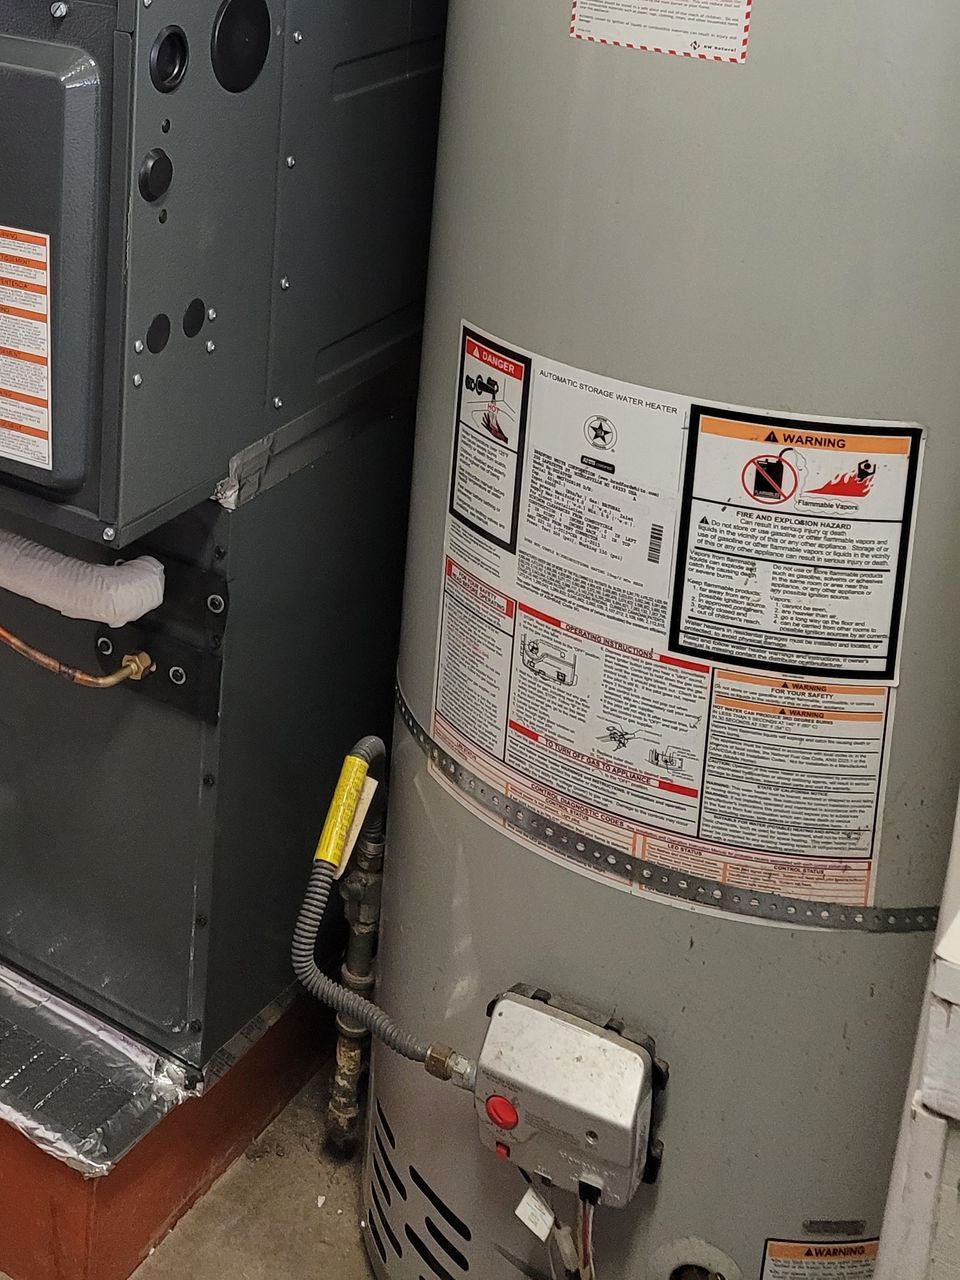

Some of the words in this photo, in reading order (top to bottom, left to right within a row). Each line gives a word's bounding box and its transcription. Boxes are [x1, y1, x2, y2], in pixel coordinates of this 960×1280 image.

[482, 350, 515, 374] DANGER
[539, 370, 578, 388] AUTOMATIC
[579, 382, 614, 399] STORAGE
[616, 393, 644, 407] WATER
[645, 401, 679, 415] HEATER
[783, 433, 846, 449] WARNING
[797, 499, 834, 509] Flammable
[736, 510, 753, 518] FIRE
[774, 517, 818, 527] EXPLOSION
[733, 524, 748, 532] store
[770, 530, 796, 539] gasoline
[806, 533, 821, 541] other
[804, 527, 820, 535] injury
[565, 624, 602, 644] OPERATING
[603, 638, 653, 659] INSTRUCTIONS
[792, 683, 827, 692] WARNING
[790, 710, 824, 718] WARNING
[544, 739, 553, 748] TO
[554, 742, 571, 756] TURN
[572, 750, 585, 762] OFF
[589, 757, 601, 769] GAS
[601, 763, 611, 771] TO
[610, 765, 651, 785] APPLIANCE
[531, 783, 559, 801] CONTROL
[561, 797, 600, 818] DIAGNOSTIC
[601, 814, 624, 827] CODES
[545, 798, 569, 812] CONTROL
[570, 808, 589, 821] STATUS
[667, 843, 679, 851] LED
[680, 847, 703, 856] STATUS
[814, 1246, 866, 1257] WARNING
